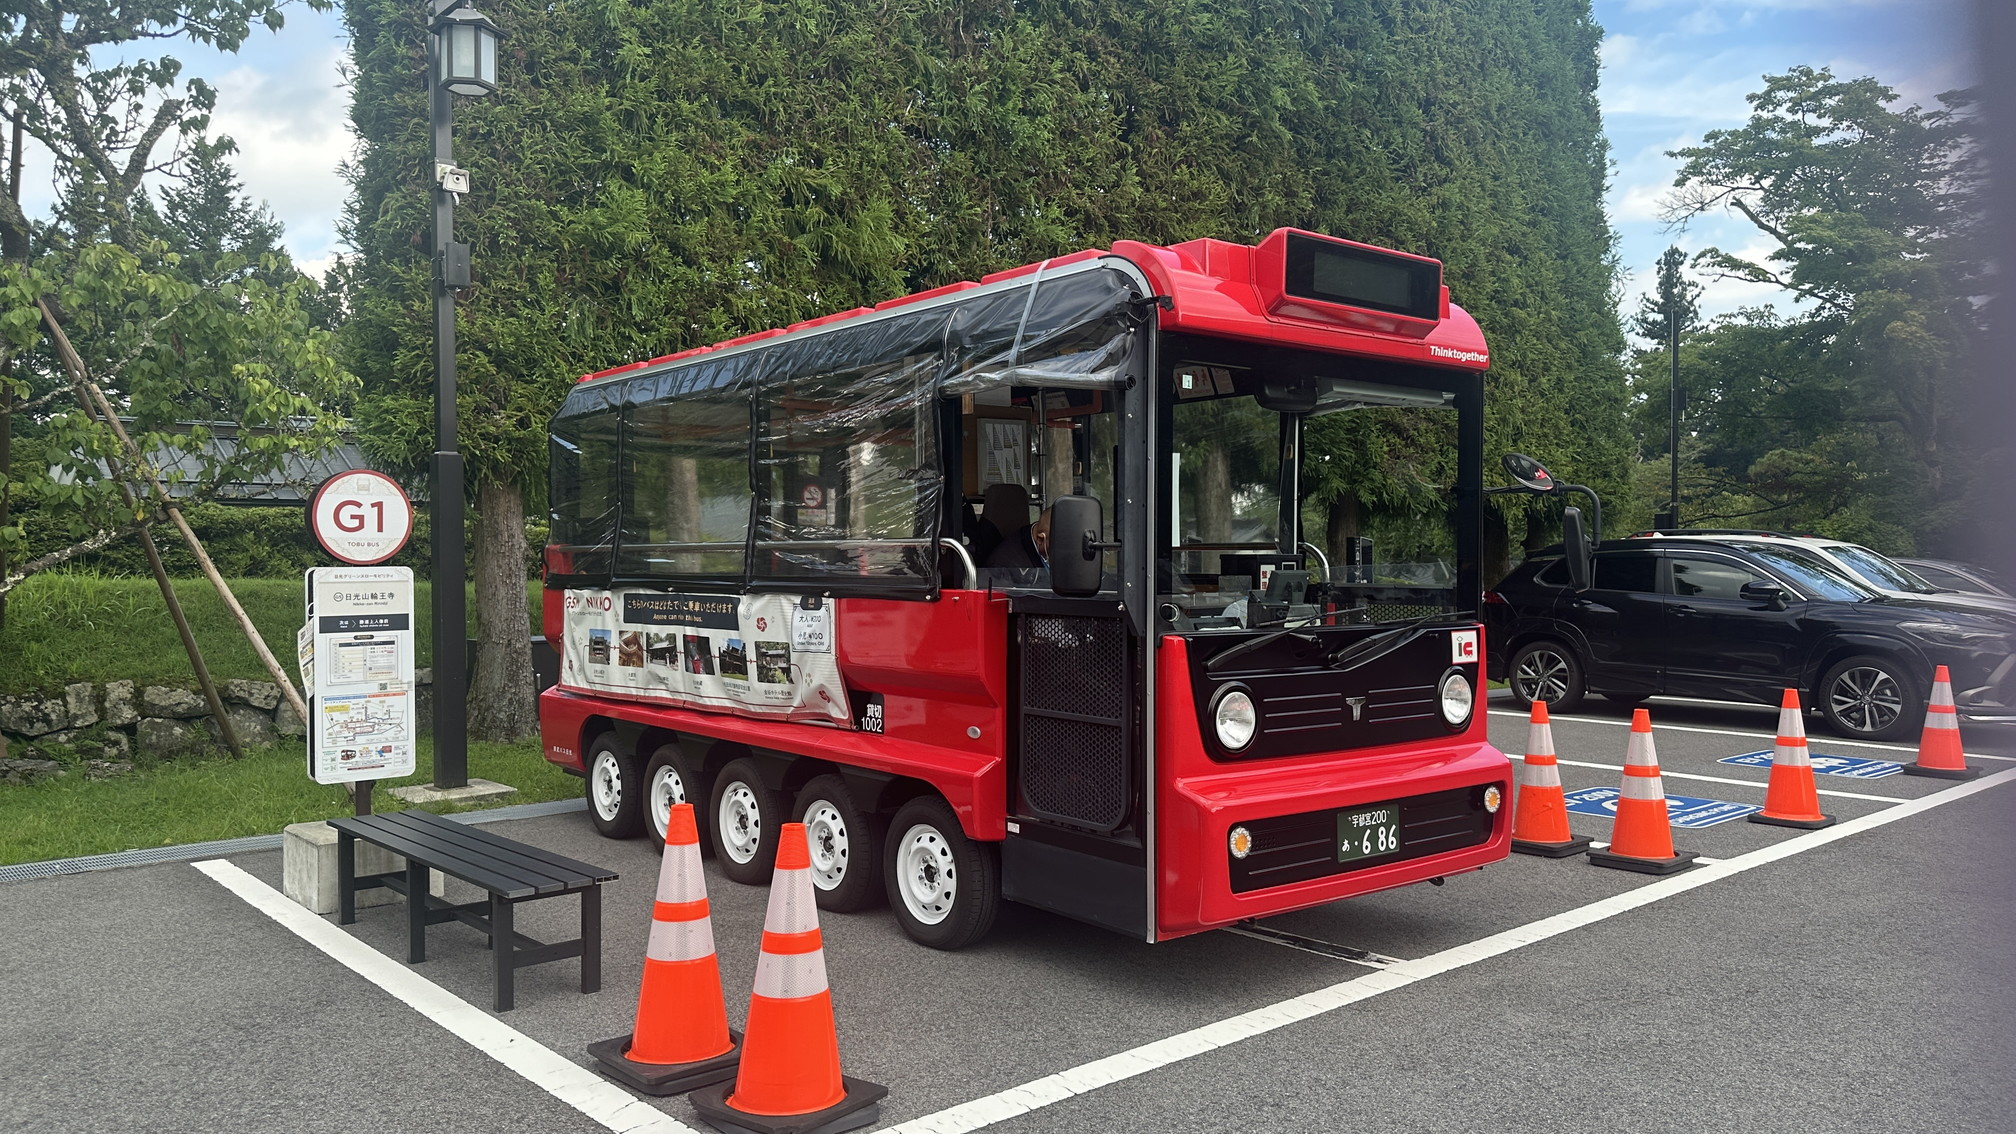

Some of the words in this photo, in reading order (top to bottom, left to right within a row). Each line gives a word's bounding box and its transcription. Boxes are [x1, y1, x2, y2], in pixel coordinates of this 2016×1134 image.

[1429, 345, 1489, 363] Thinktogether
[333, 499, 384, 533] G1
[345, 592, 395, 601] 日光山輪王寺
[866, 703, 882, 718] 貸切
[861, 716, 882, 732] 1002
